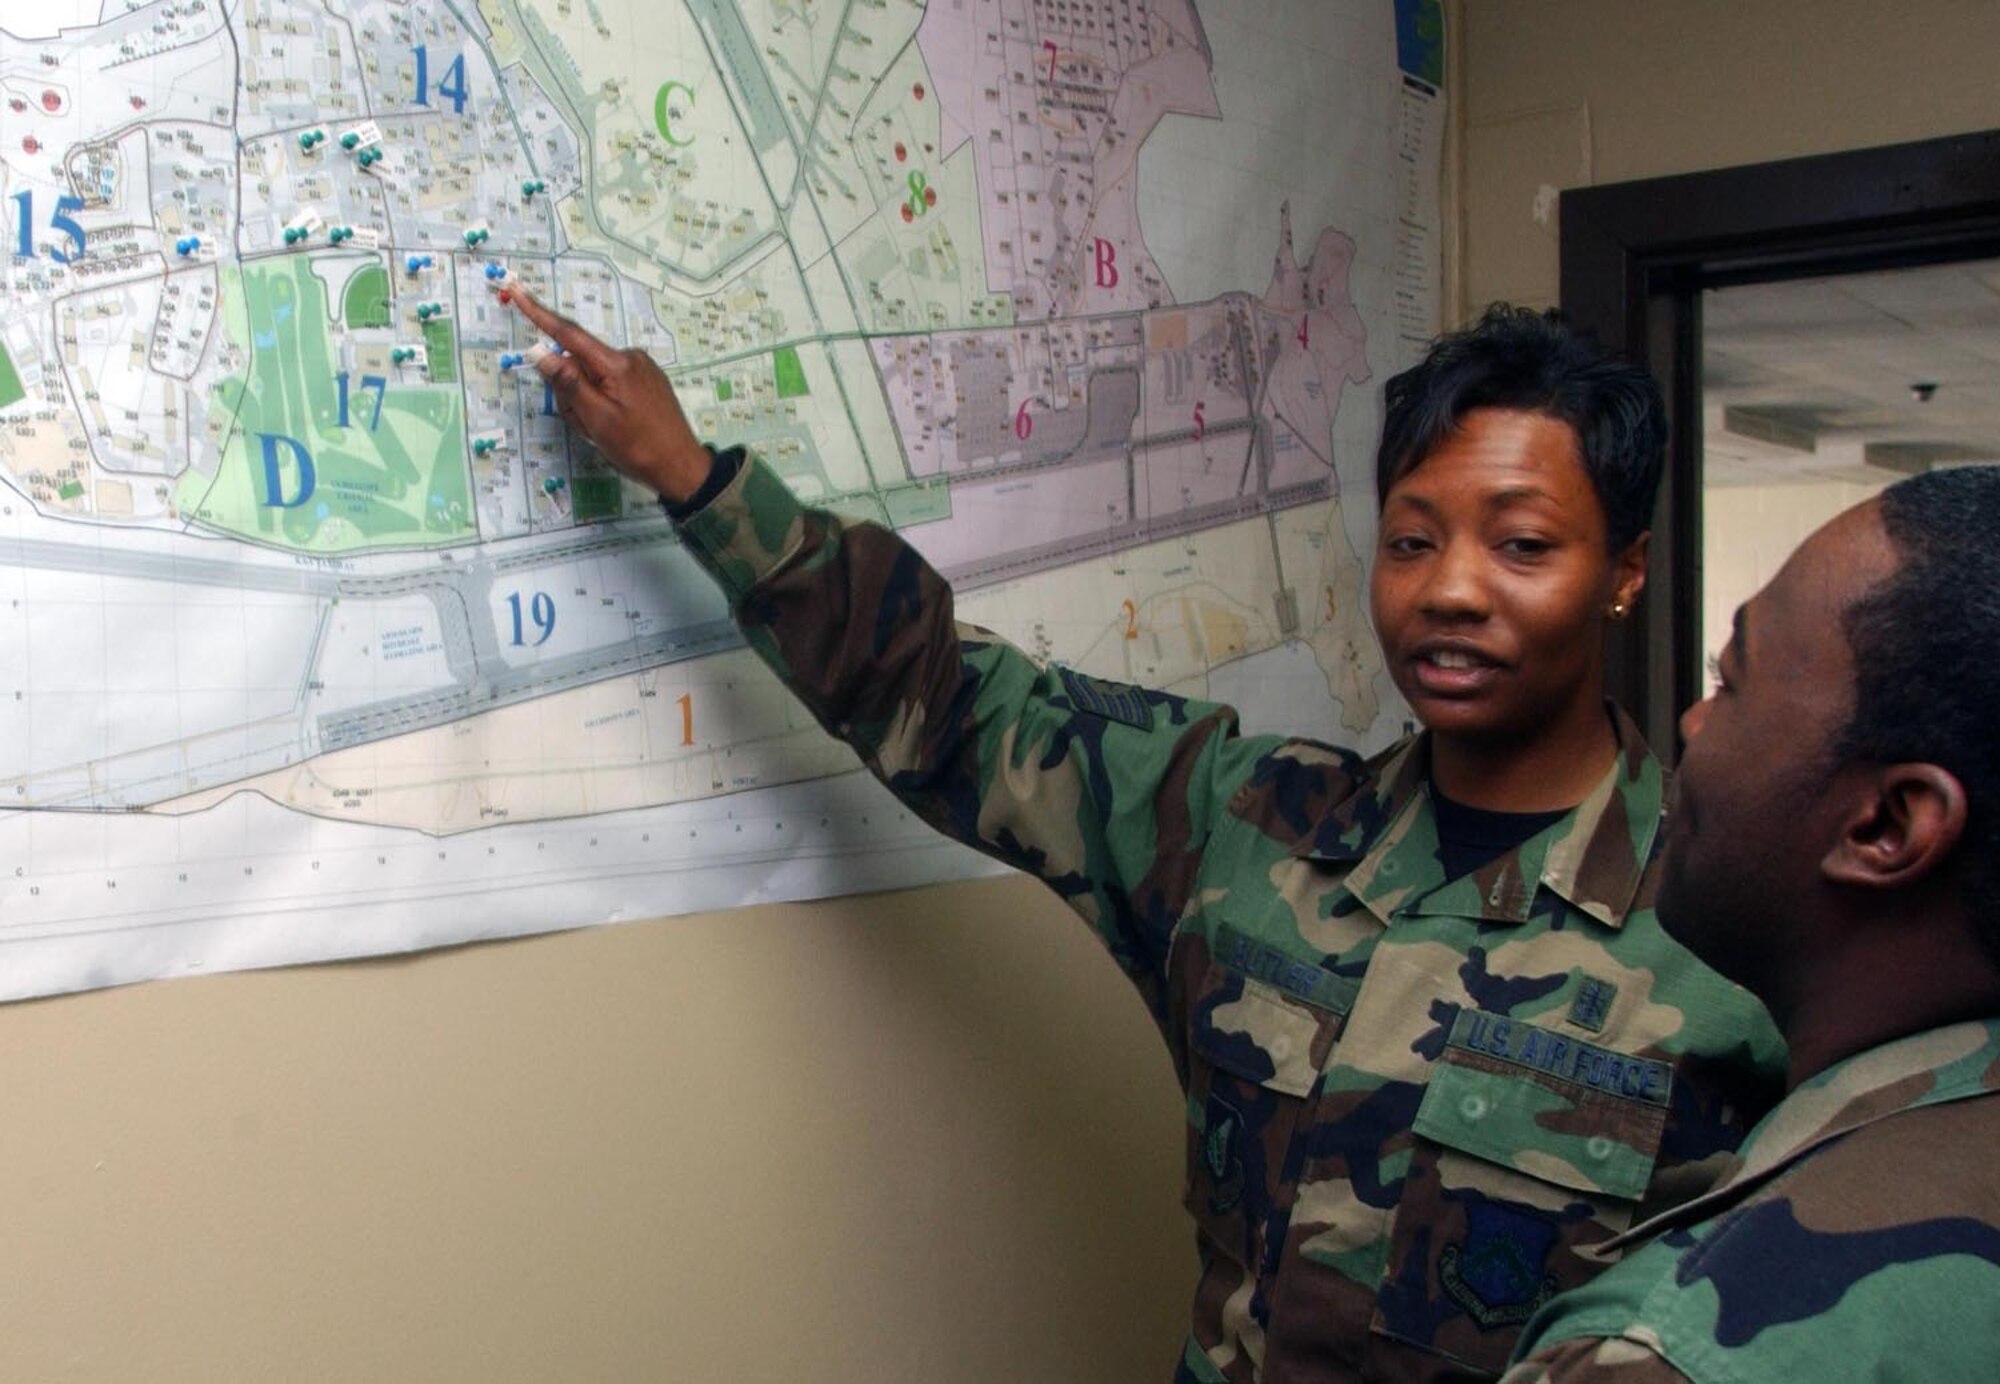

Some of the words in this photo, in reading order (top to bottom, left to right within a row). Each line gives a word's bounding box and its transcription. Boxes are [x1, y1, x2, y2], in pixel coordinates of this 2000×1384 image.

[411, 44, 469, 114] 14
[654, 80, 696, 147] C
[908, 170, 928, 217] 8
[9, 189, 86, 264] 15
[1094, 237, 1119, 289] B
[1297, 313, 1309, 350] 4
[335, 371, 386, 431] 17
[1015, 396, 1038, 440] 6
[1192, 401, 1205, 442] 5
[254, 432, 316, 508] D
[505, 591, 557, 648] 19
[1122, 598, 1139, 640] 2
[676, 693, 694, 747] 1
[1468, 1016, 1511, 1059] U.S.
[1519, 1030, 1569, 1075] AIR
[1573, 1047, 1659, 1097] FORCE
